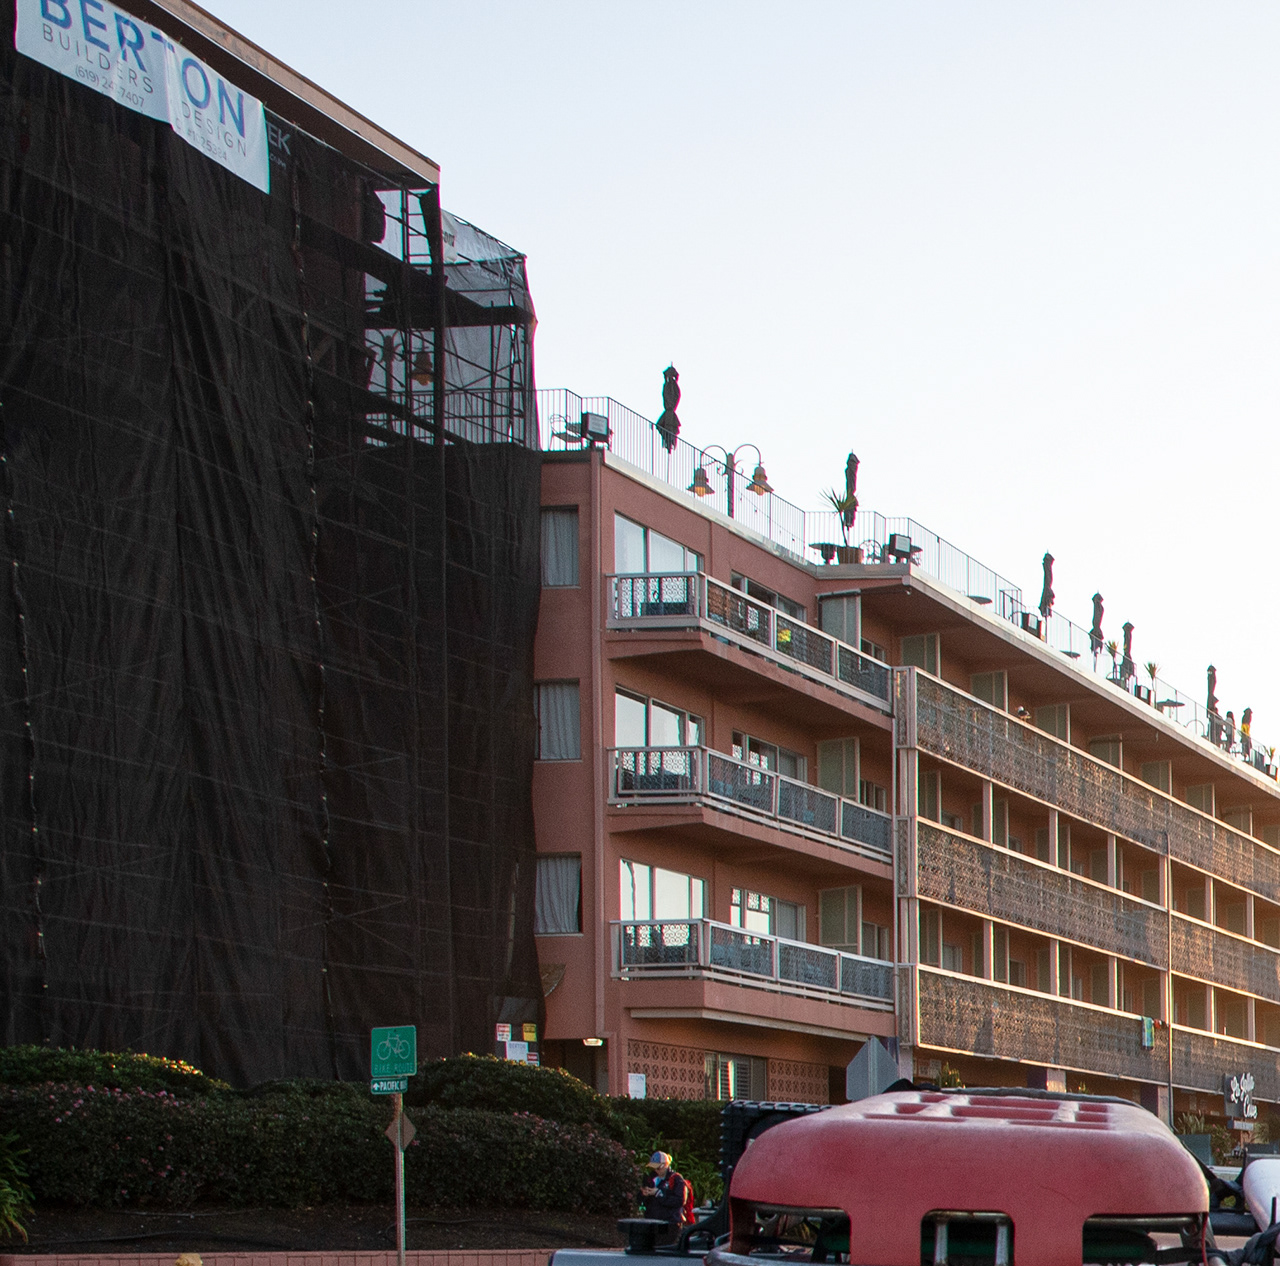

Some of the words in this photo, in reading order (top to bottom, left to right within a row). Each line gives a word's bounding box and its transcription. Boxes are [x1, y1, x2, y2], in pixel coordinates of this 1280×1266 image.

[42, 23, 154, 94] BUILDERS
[181, 101, 247, 158] DESIGN
[75, 65, 100, 87] (619)
[101, 76, 145, 108] 24-7407
[380, 1080, 400, 1091] PACIFIC
